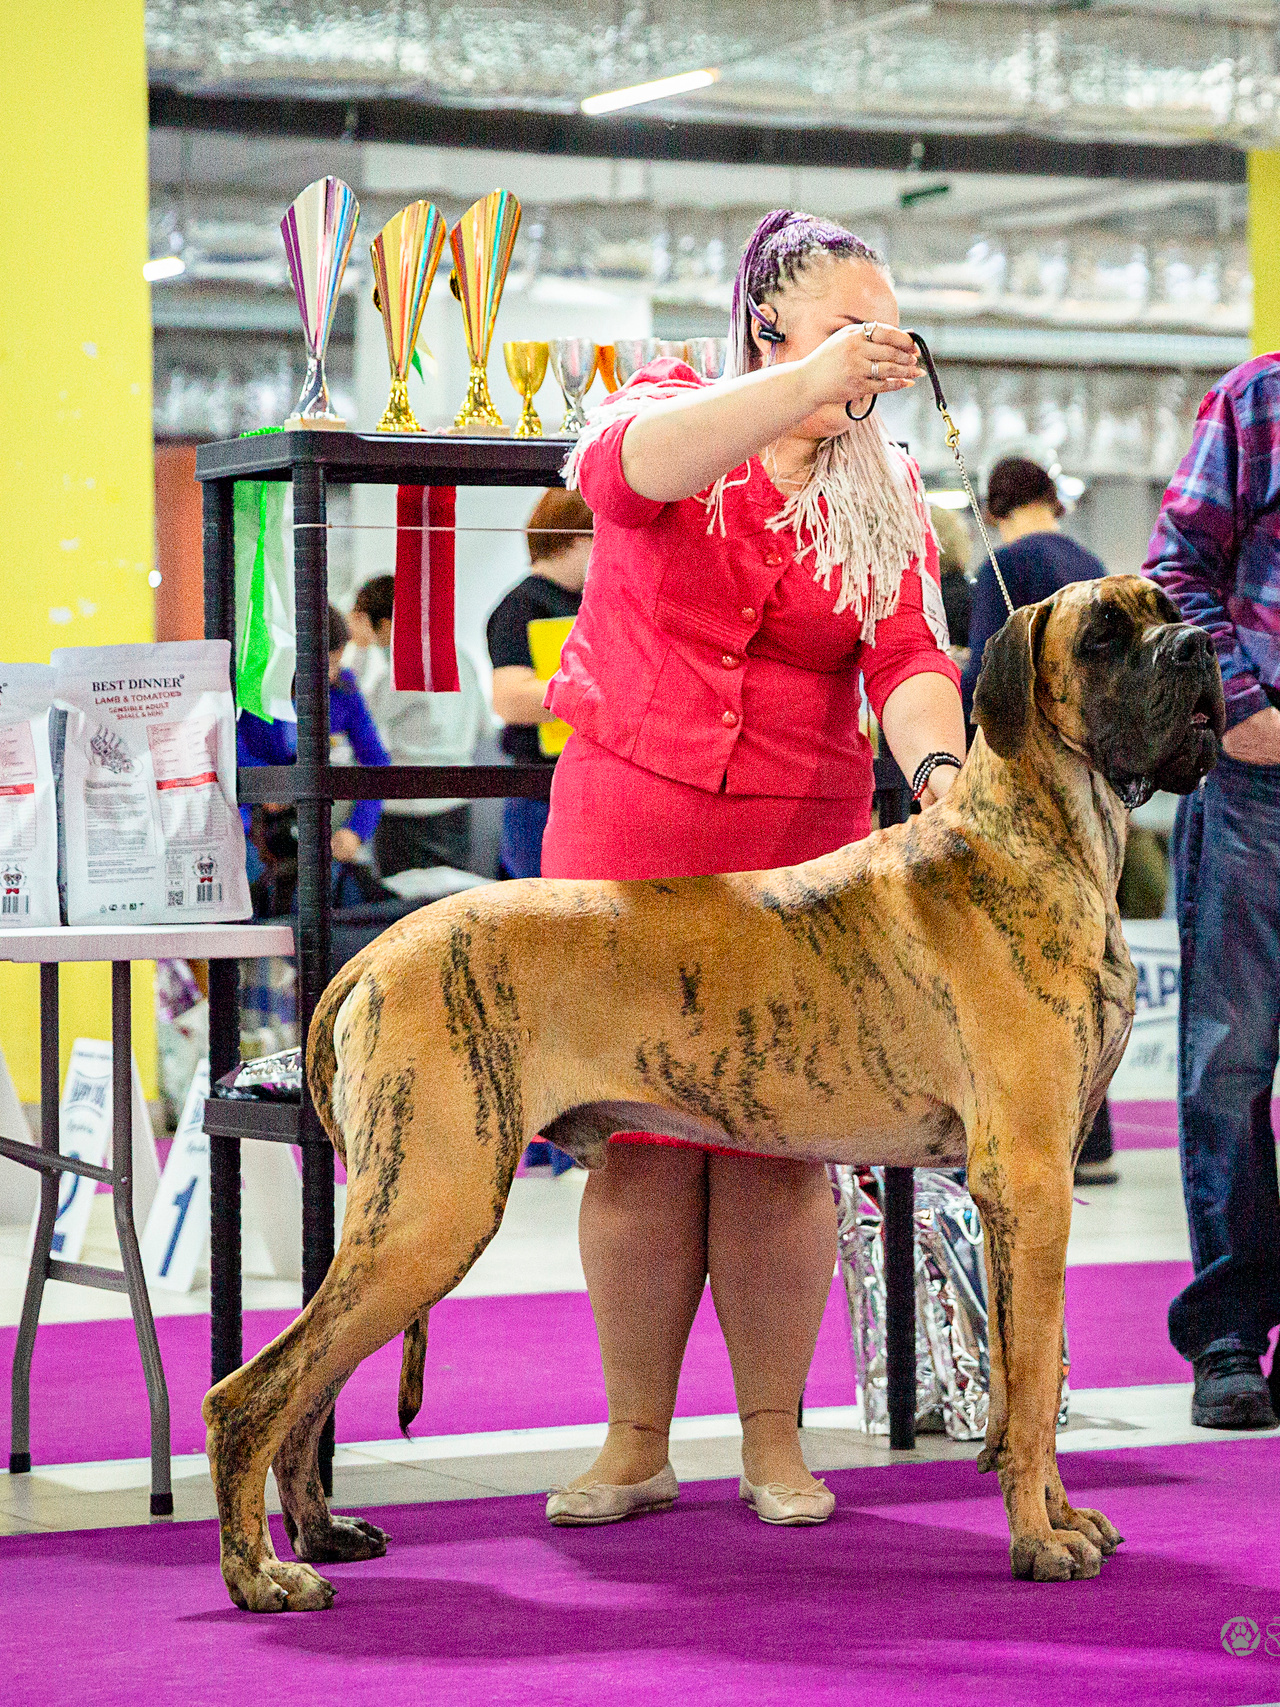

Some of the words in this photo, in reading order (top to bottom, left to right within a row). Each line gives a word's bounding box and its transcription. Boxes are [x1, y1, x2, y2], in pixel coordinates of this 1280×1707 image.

[92, 680, 125, 691] BEST
[129, 677, 182, 690] DINNER
[95, 695, 121, 705] LAMB
[160, 1176, 198, 1278] 1
